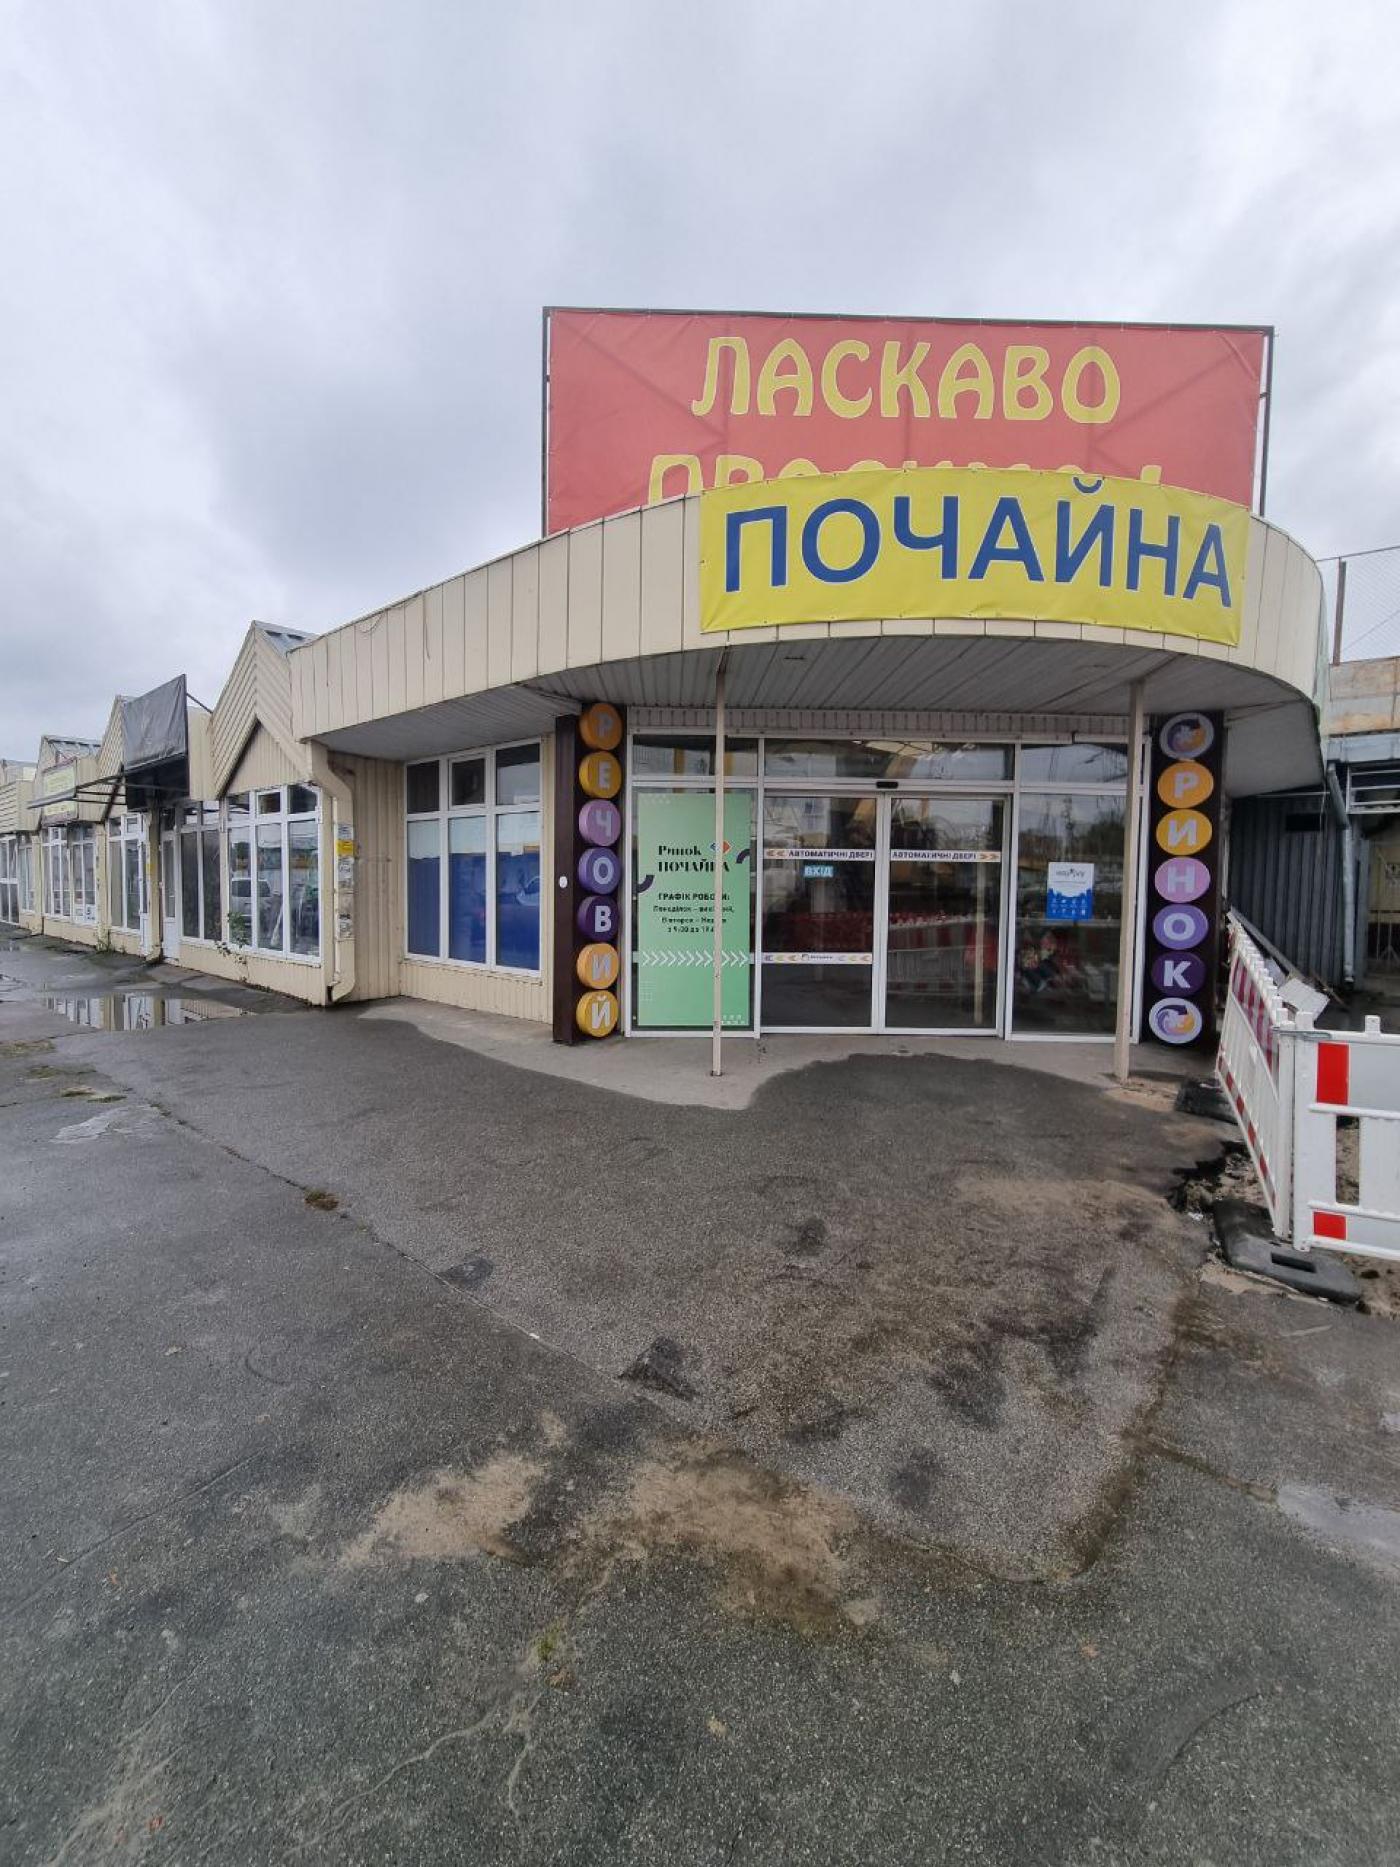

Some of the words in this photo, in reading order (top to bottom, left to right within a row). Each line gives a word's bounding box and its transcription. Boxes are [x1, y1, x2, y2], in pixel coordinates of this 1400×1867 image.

[692, 336, 1121, 424] ЛАСКАВО
[725, 476, 1232, 608] ПОЧАЙНА
[592, 712, 614, 1029] РЕЧОВИЙ
[788, 850, 848, 858] АВТОМАТИЧНІ
[803, 865, 834, 878] ВХІД
[892, 851, 951, 859] АВТОМАТИЧНІ
[658, 893, 691, 901] ГРАФІК
[692, 893, 730, 901] РОБОИ:
[1163, 771, 1199, 988] РИНОК
